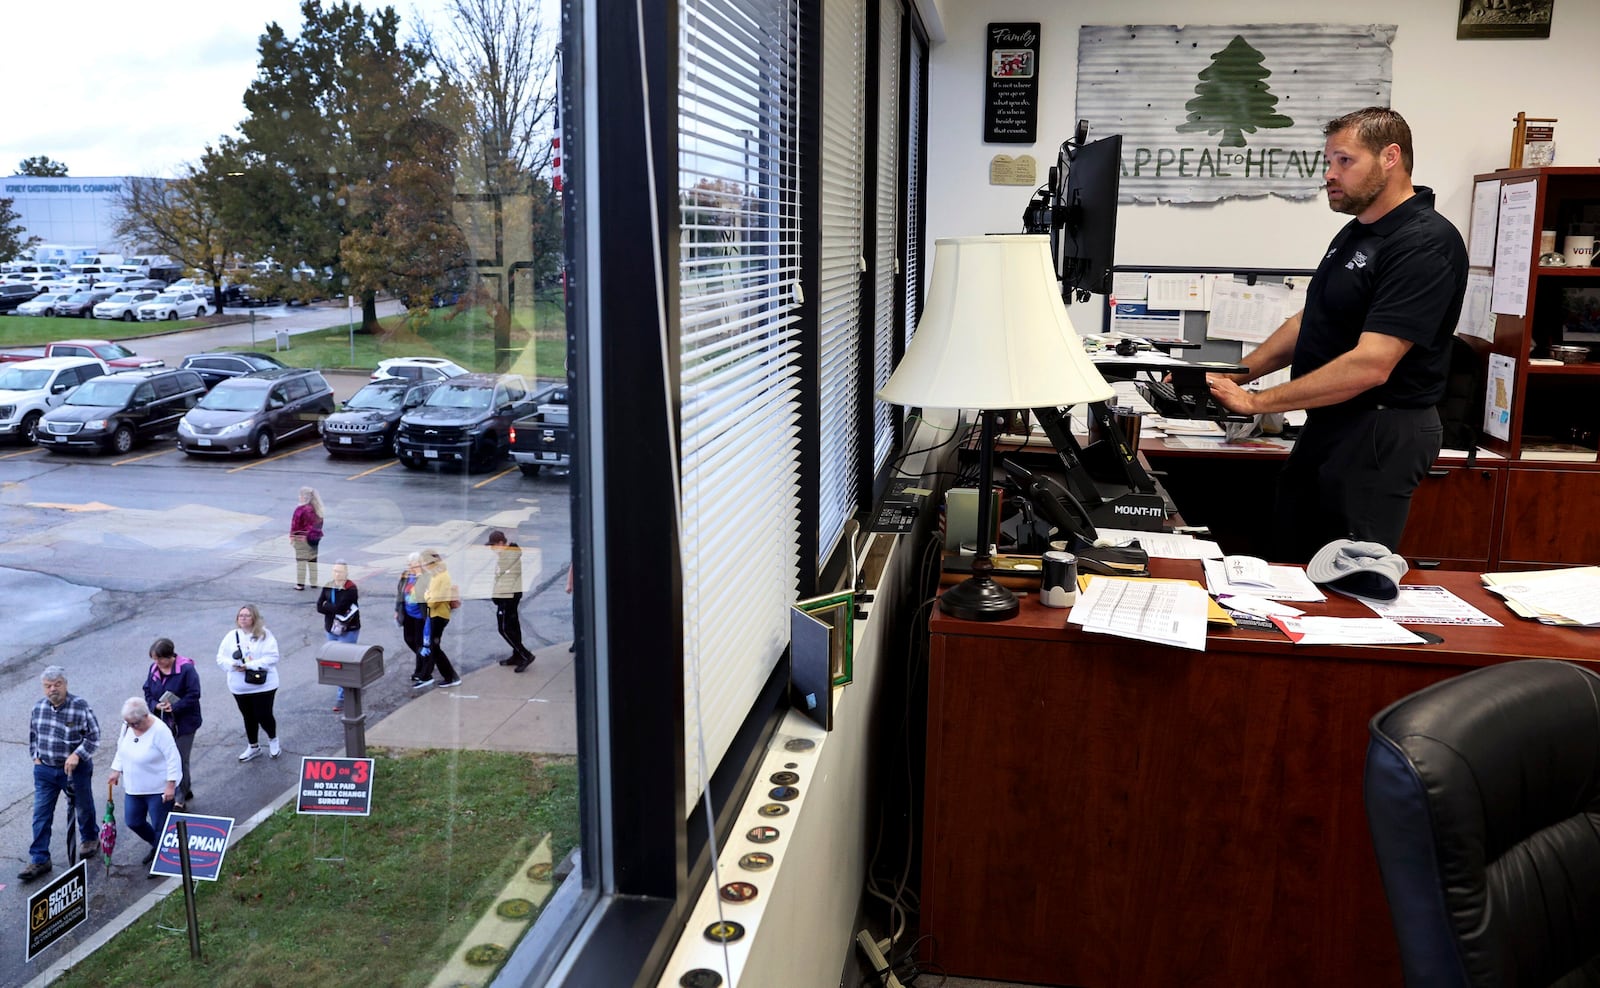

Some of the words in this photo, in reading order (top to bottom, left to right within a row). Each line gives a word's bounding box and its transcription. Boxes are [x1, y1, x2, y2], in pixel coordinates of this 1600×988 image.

[992, 28, 1036, 47] Family
[1225, 153, 1245, 165] TO
[1245, 148, 1327, 178] HEAV
[27, 184, 81, 192] DISTRIBUTING
[82, 184, 122, 193] COMPANY
[1573, 247, 1593, 255] VOTE
[305, 761, 337, 780] NO
[351, 761, 369, 783] 3
[163, 832, 225, 852] CHPMAN
[48, 875, 79, 906] SCOTT
[48, 885, 84, 920] MILLER
